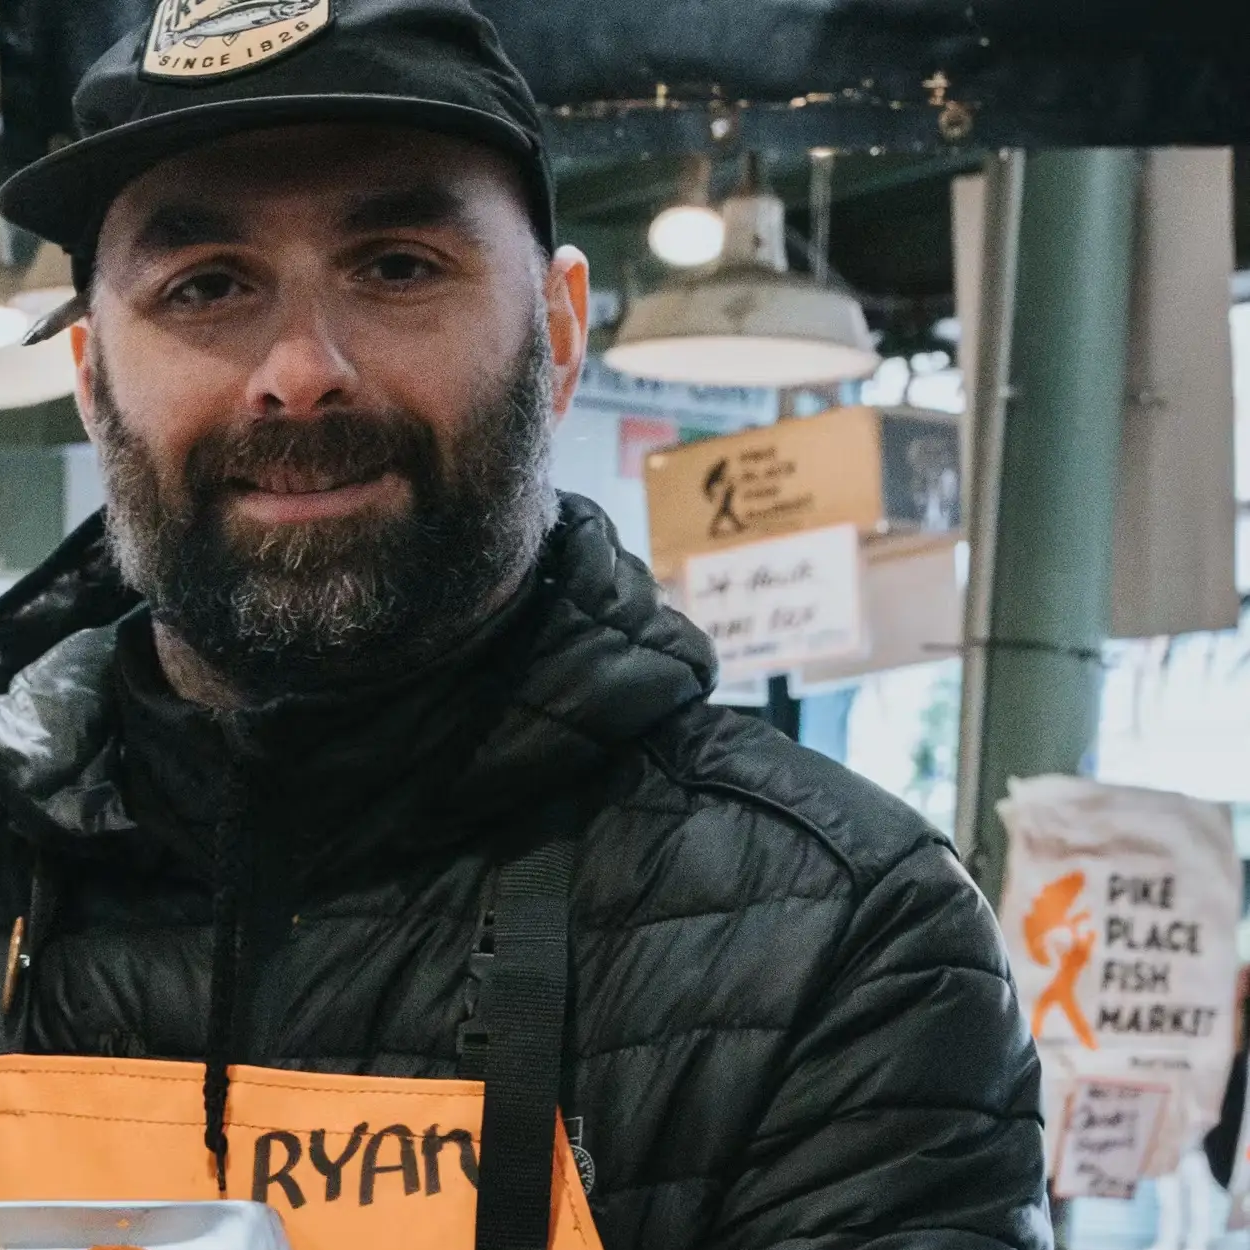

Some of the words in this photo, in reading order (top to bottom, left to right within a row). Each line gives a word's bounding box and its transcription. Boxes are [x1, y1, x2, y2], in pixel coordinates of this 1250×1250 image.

[158, 53, 230, 70] SINCE
[1106, 871, 1176, 910] PIKE
[1104, 914, 1202, 955] PLACE
[1100, 958, 1171, 993] FISH
[1095, 1003, 1218, 1037] MARKET
